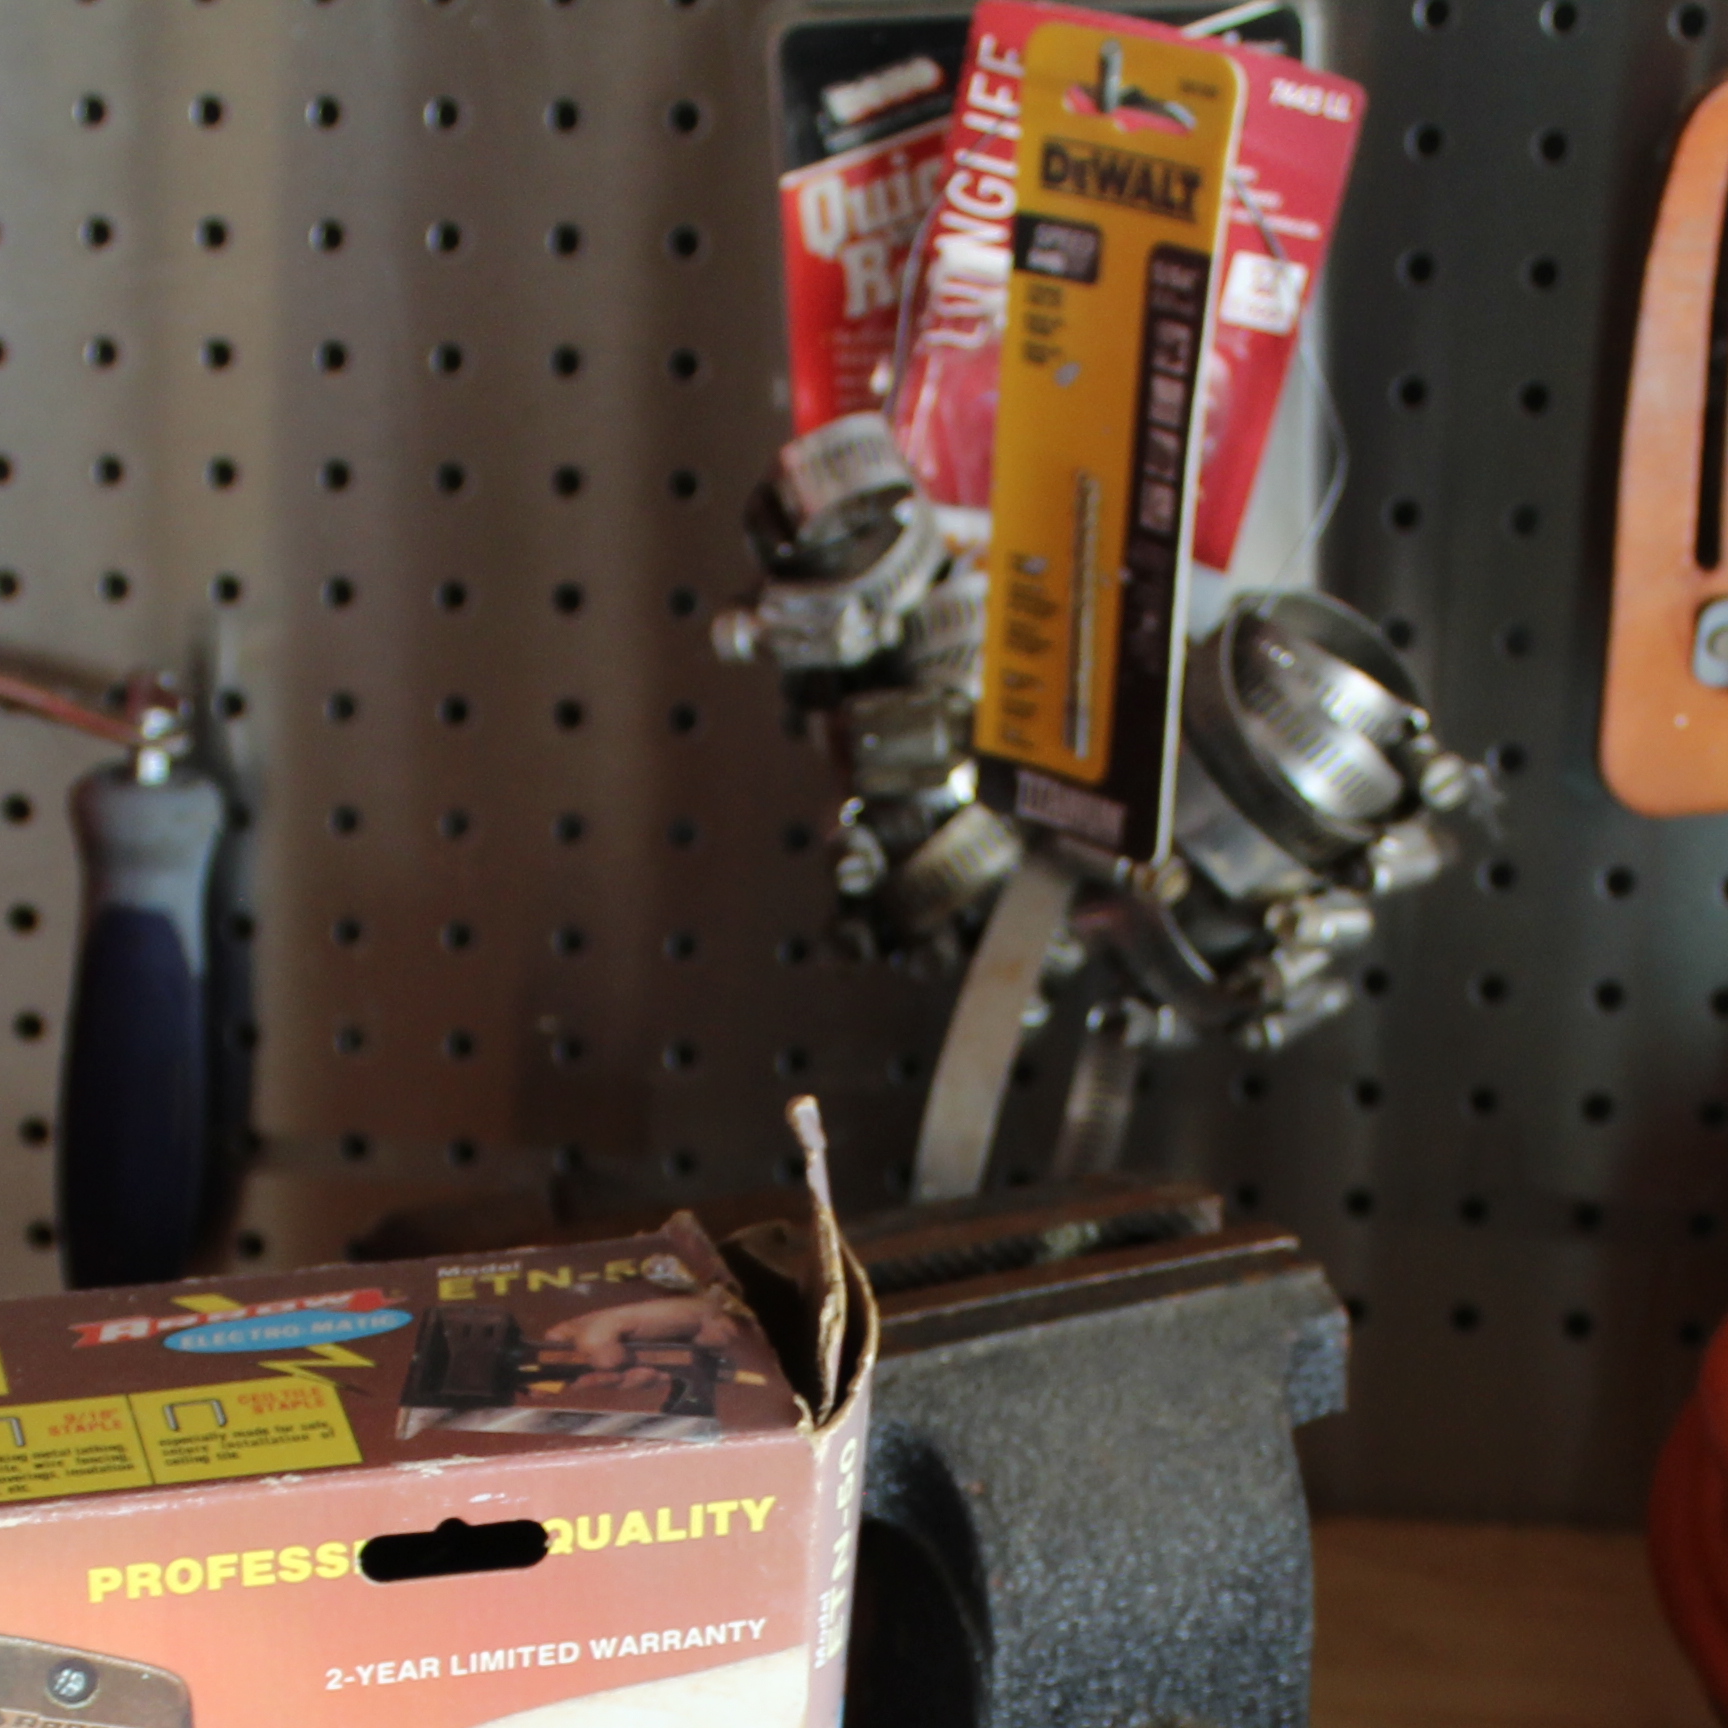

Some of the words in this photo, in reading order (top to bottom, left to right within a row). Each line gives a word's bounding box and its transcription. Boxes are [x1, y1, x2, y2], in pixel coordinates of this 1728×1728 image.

[87, 1539, 367, 1603] PROFESS
[544, 1496, 777, 1557] QUALITY
[325, 1654, 442, 1690] 2-YEAR
[449, 1640, 582, 1677] LIMITED
[589, 1617, 768, 1662] WARRANTY
